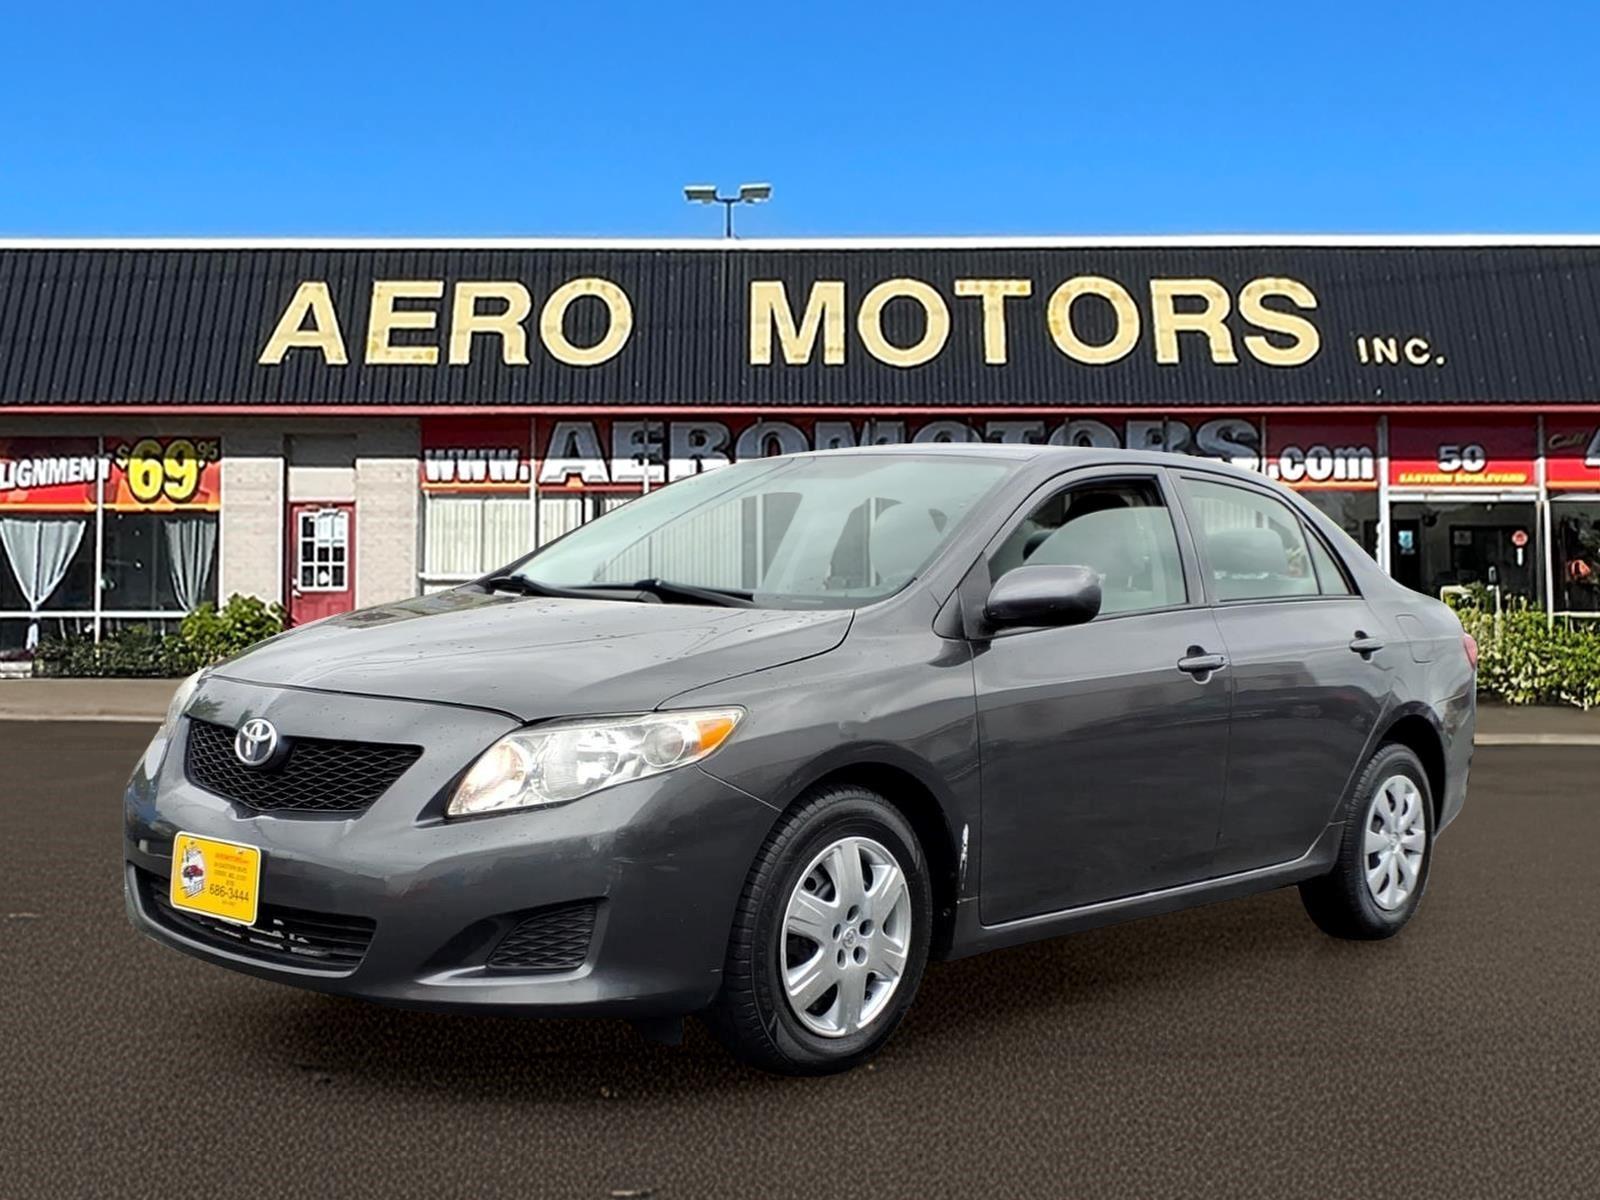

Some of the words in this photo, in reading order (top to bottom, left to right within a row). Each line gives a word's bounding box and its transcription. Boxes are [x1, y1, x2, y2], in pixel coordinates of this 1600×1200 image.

[258, 278, 633, 366] AERO
[750, 276, 1320, 367] MOTORS
[1357, 337, 1446, 365] INC.
[1438, 445, 1486, 472] 50
